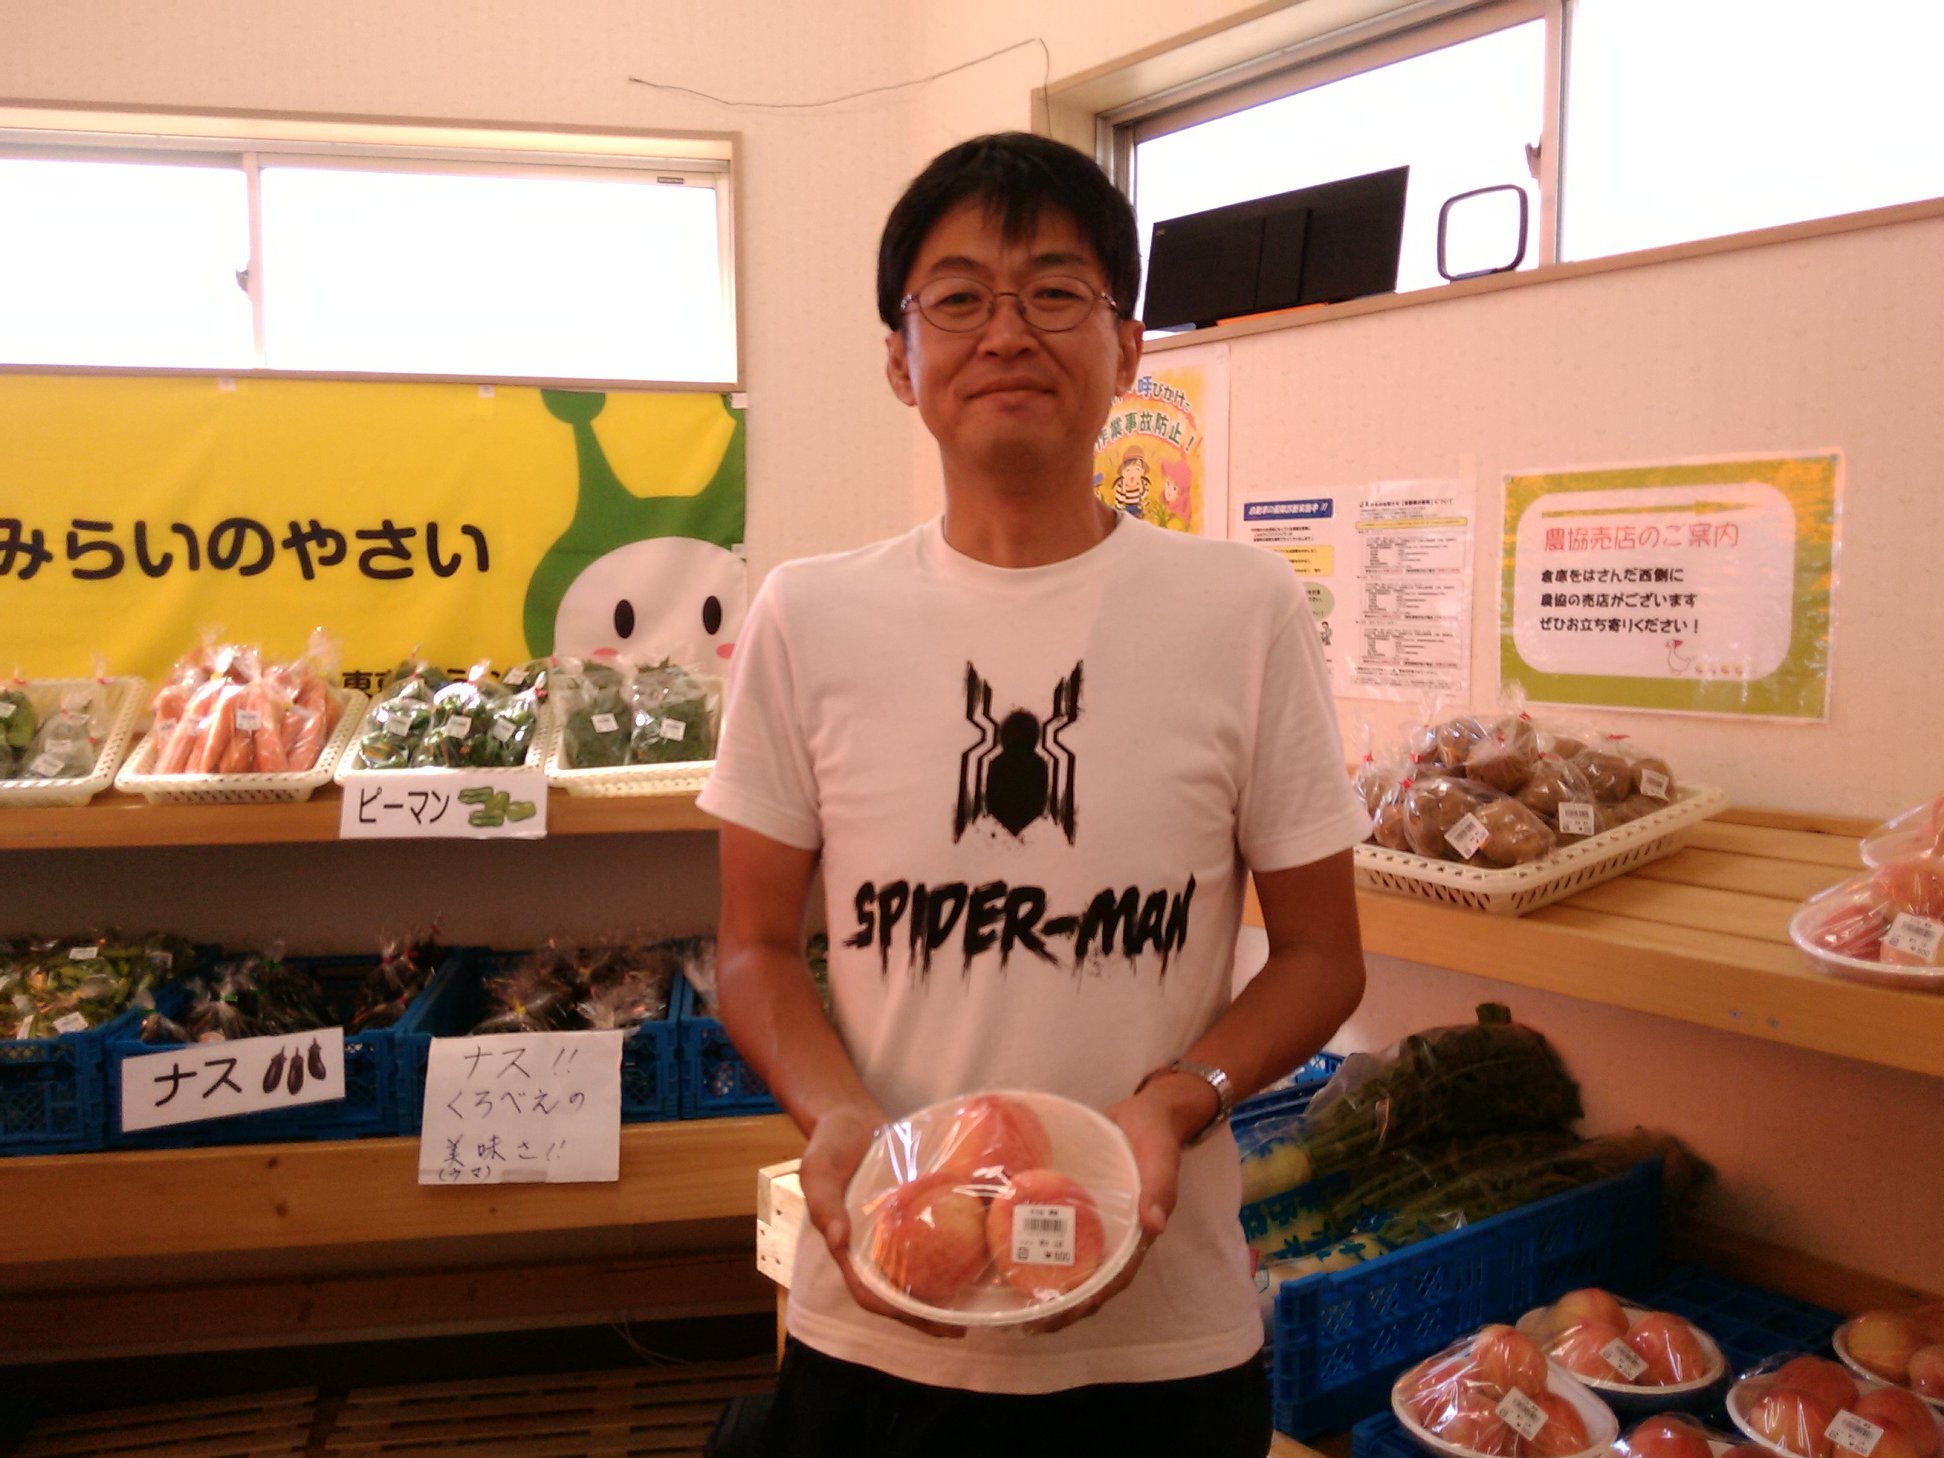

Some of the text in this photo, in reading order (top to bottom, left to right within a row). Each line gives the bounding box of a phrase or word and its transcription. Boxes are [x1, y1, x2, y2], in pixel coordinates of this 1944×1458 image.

[0, 517, 489, 580] みらいのやさい
[1544, 523, 1740, 552] 農協売店のご案内
[1541, 567, 1684, 584] 倉庫をはさんだ西側に
[1540, 593, 1698, 609] 農協の売店がございます
[359, 786, 450, 824] ピーマン
[844, 872, 1196, 984] SPIDER-MAN
[153, 1057, 242, 1108] ナス
[446, 1088, 587, 1120] くろべえの
